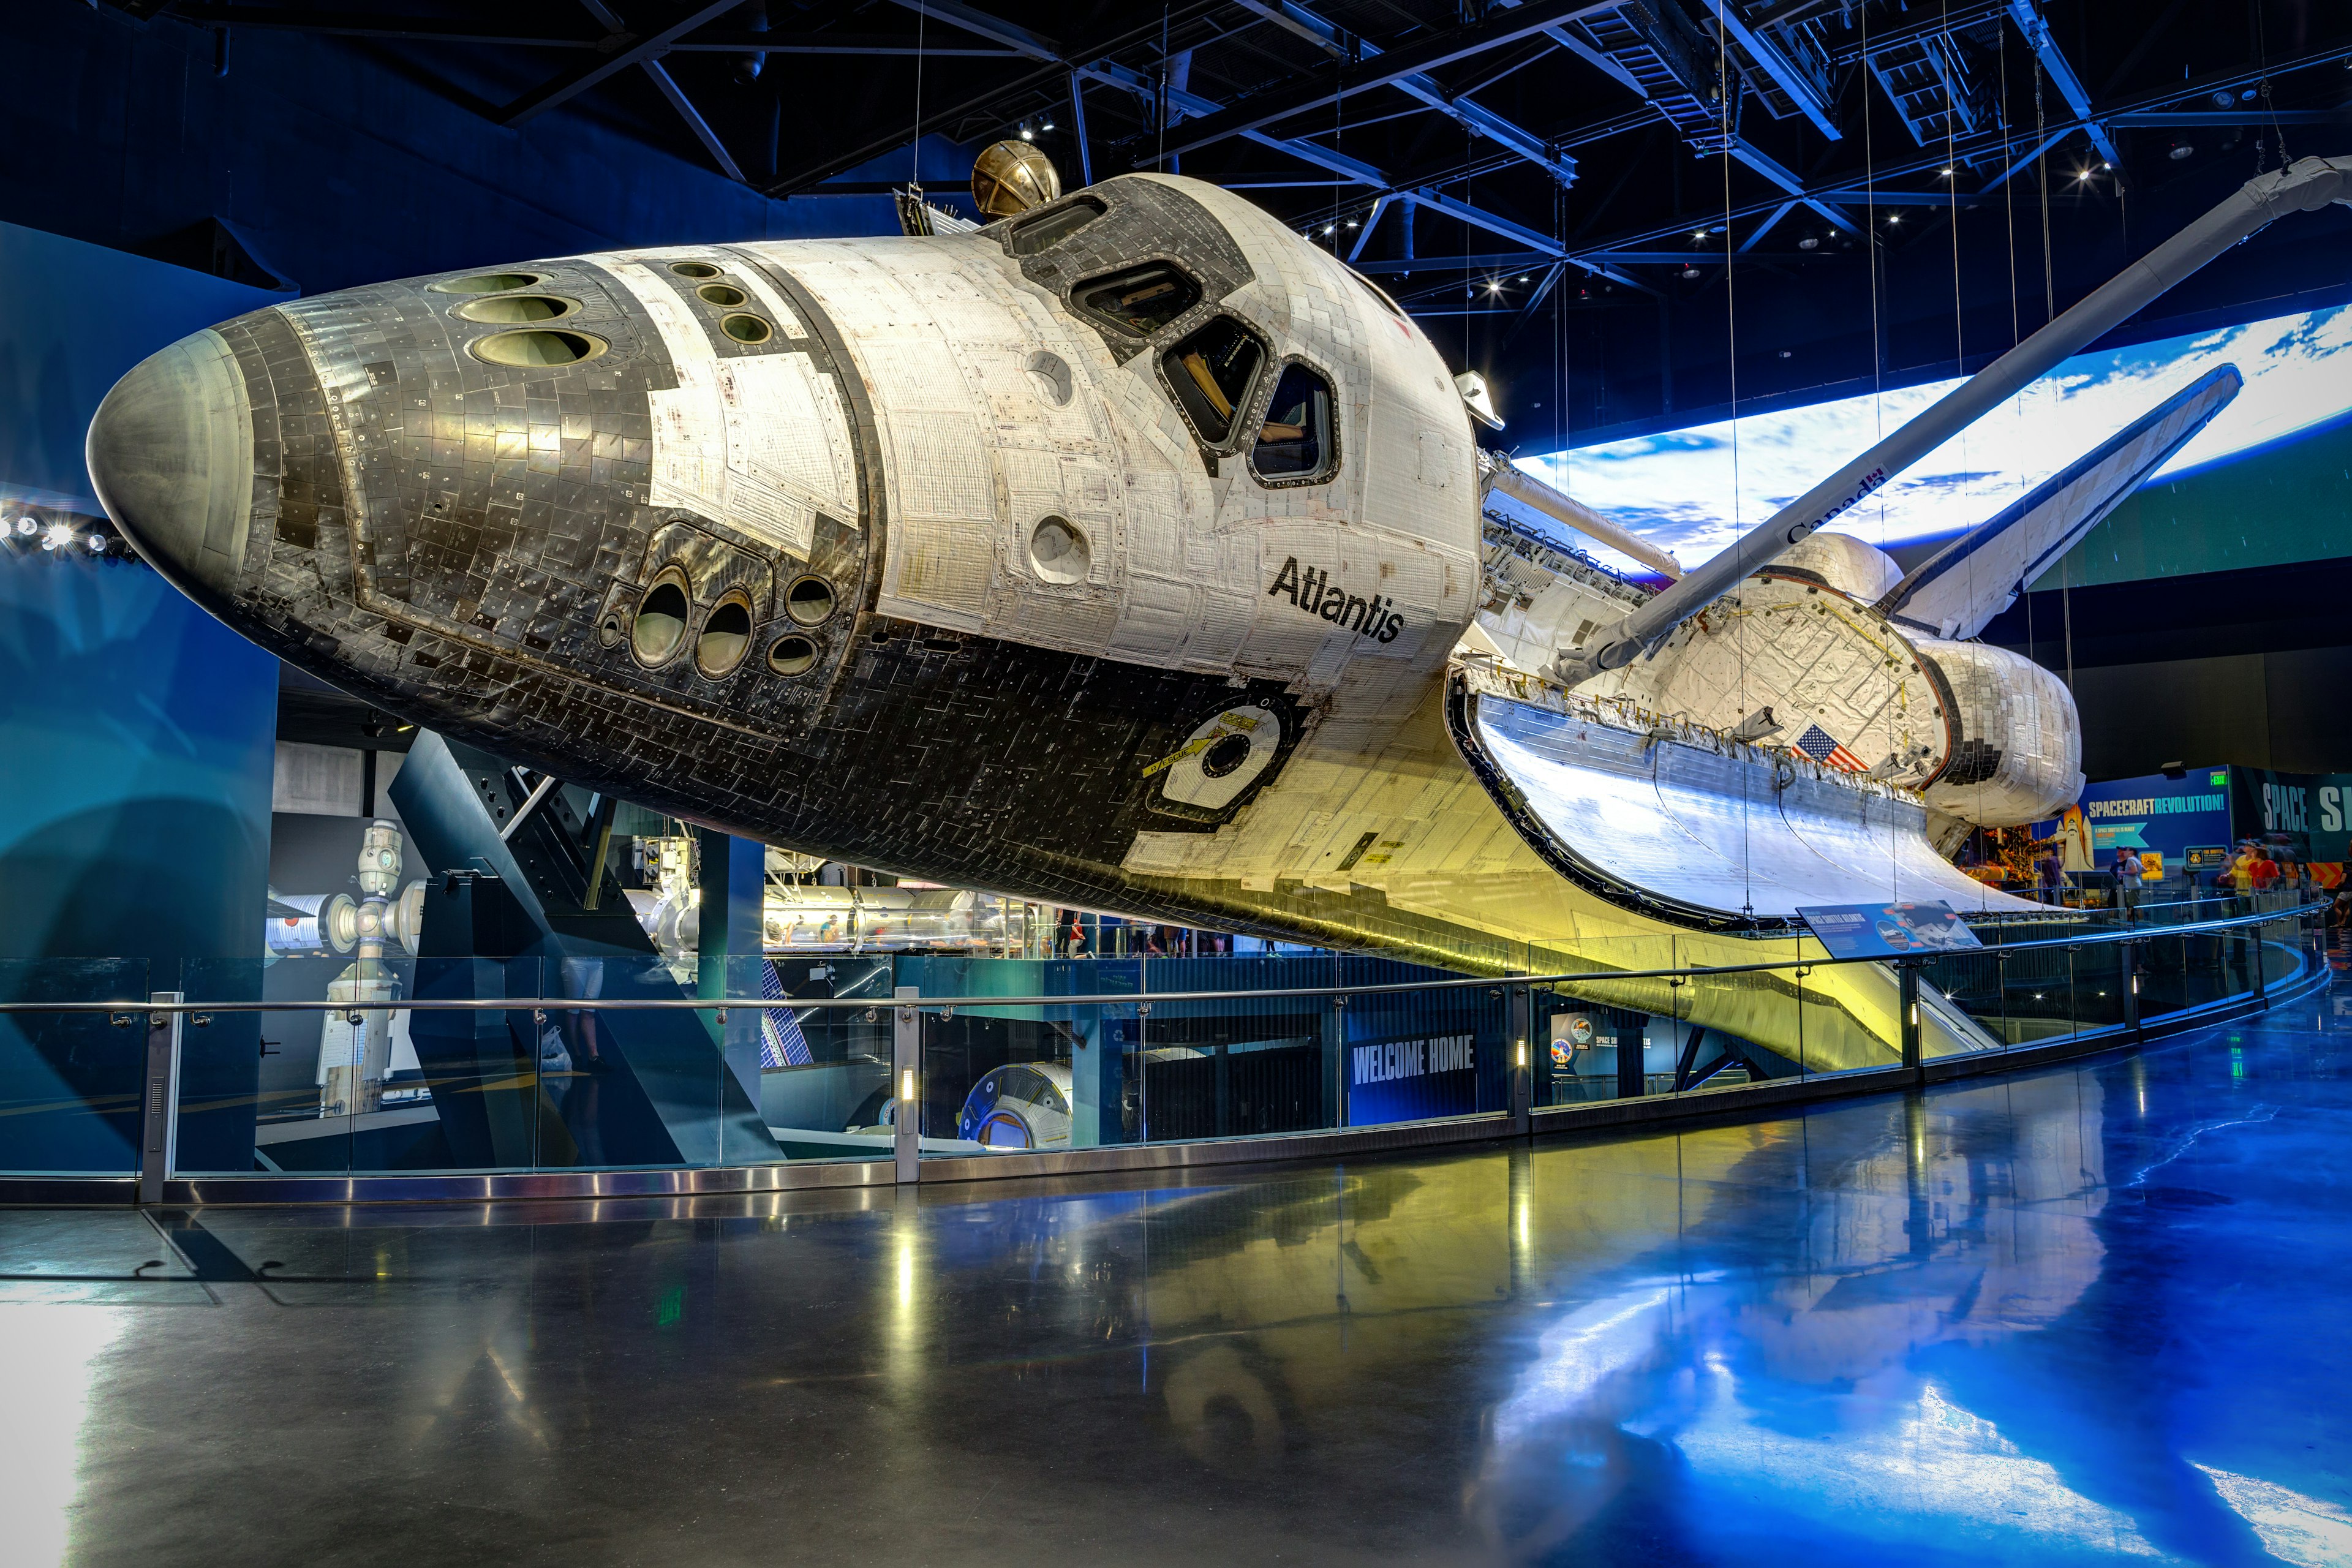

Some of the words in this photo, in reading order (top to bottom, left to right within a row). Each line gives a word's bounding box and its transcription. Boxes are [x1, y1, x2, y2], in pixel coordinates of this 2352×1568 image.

[1787, 475, 1887, 544] Canada
[1268, 556, 1404, 644] Atlantis
[1152, 750, 1189, 772] RESCUE
[2215, 775, 2225, 784] EXIT
[2263, 783, 2308, 832] SPACE
[1807, 916, 1825, 924] SPACE
[1353, 1039, 1425, 1085] WELCOME
[1429, 1035, 1474, 1074] HOME
